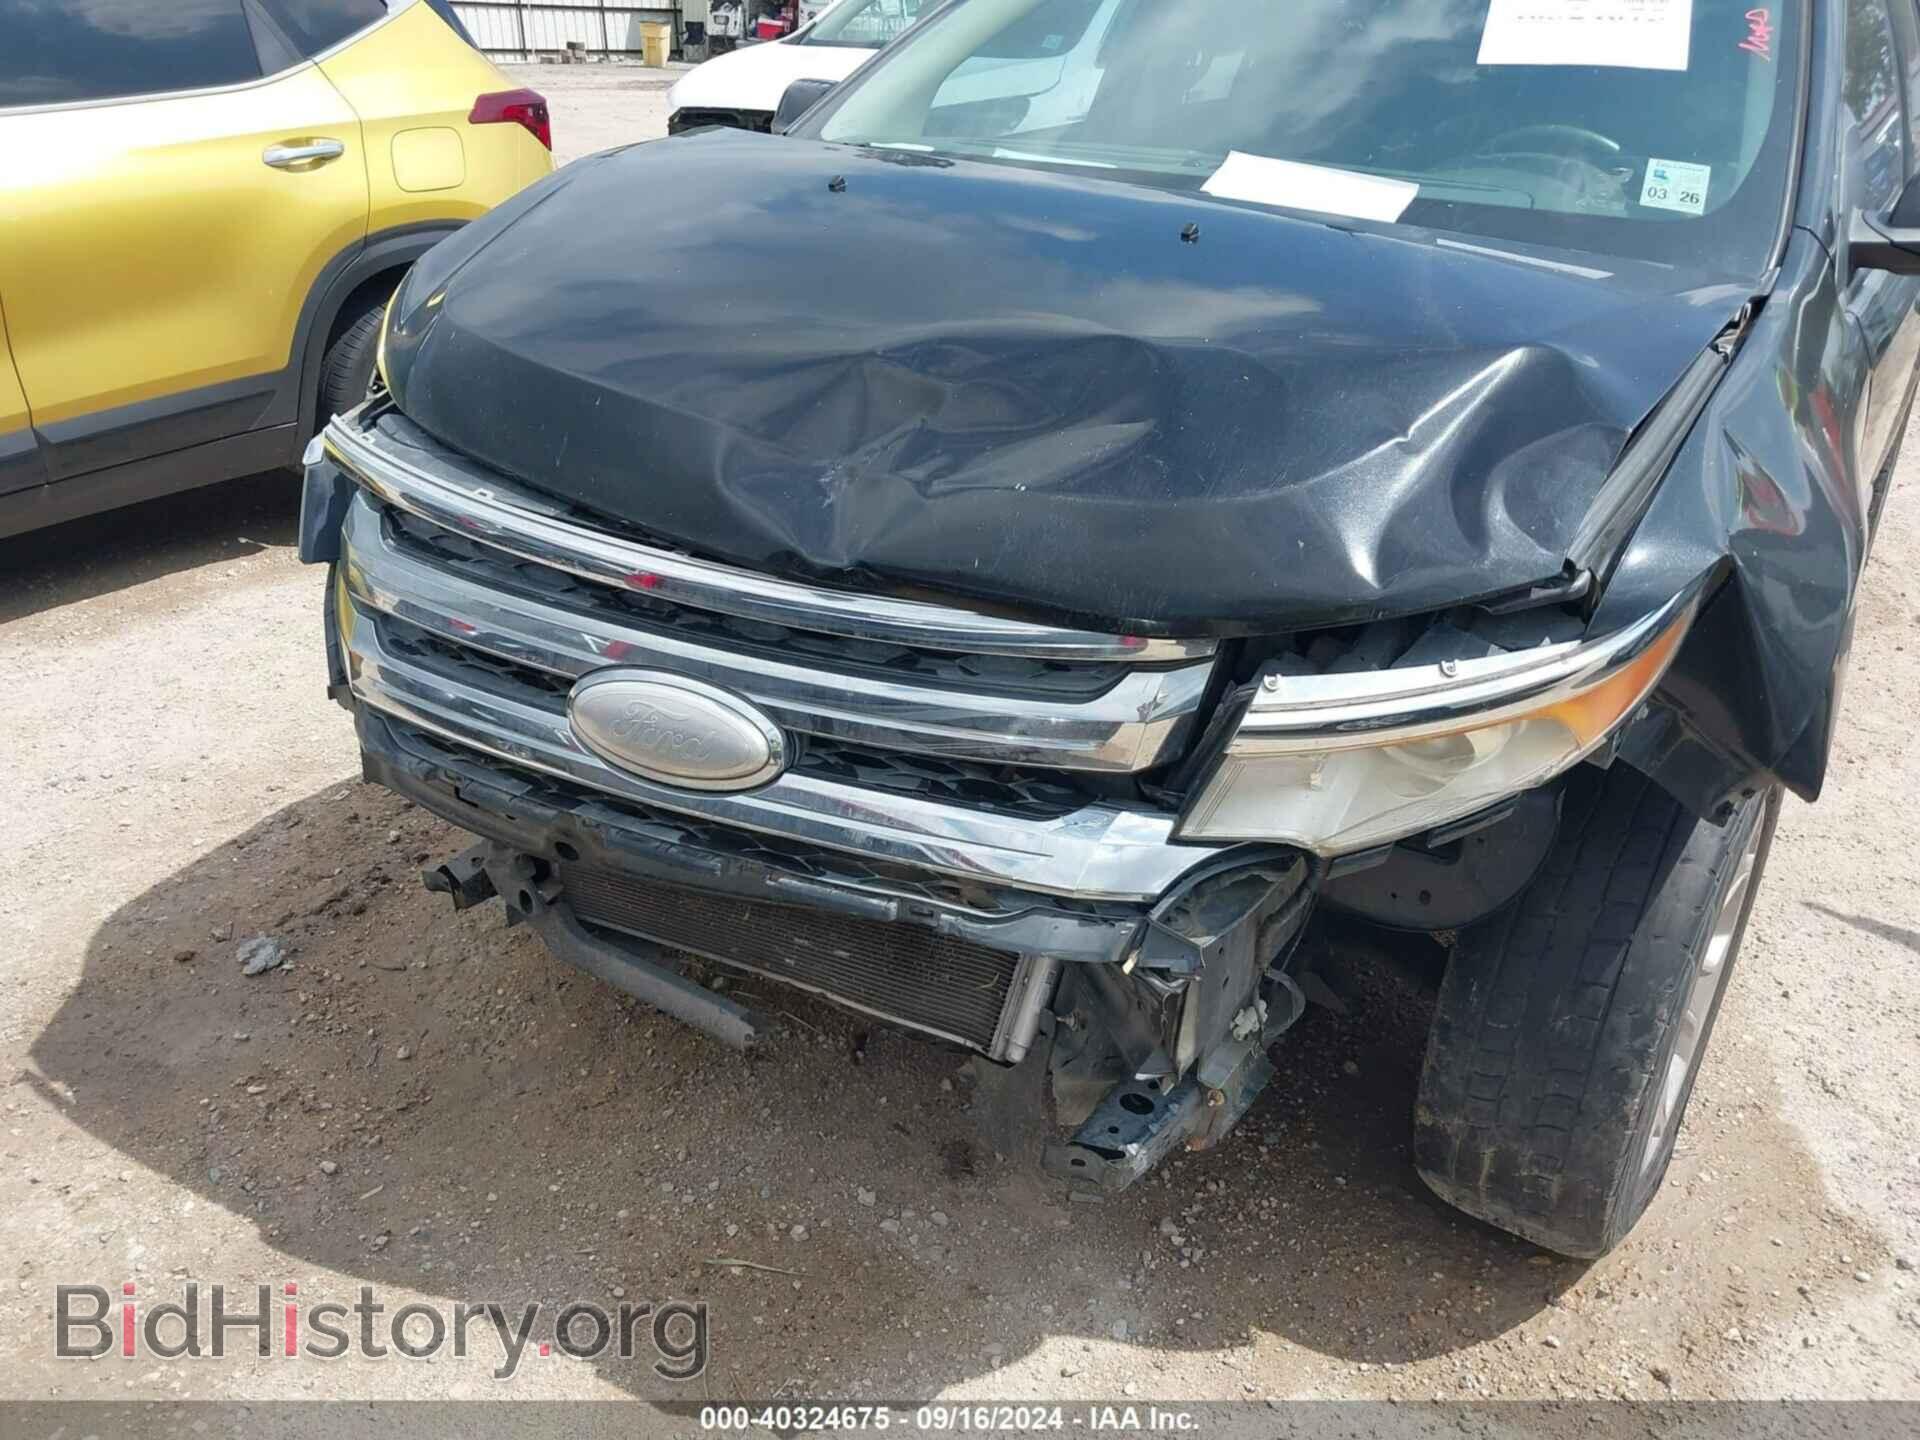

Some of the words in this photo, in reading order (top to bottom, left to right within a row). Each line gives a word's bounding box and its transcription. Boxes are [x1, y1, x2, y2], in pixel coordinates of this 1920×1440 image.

[1647, 186, 1668, 200] 03
[1679, 190, 1700, 204] 26
[610, 699, 717, 762] Ford
